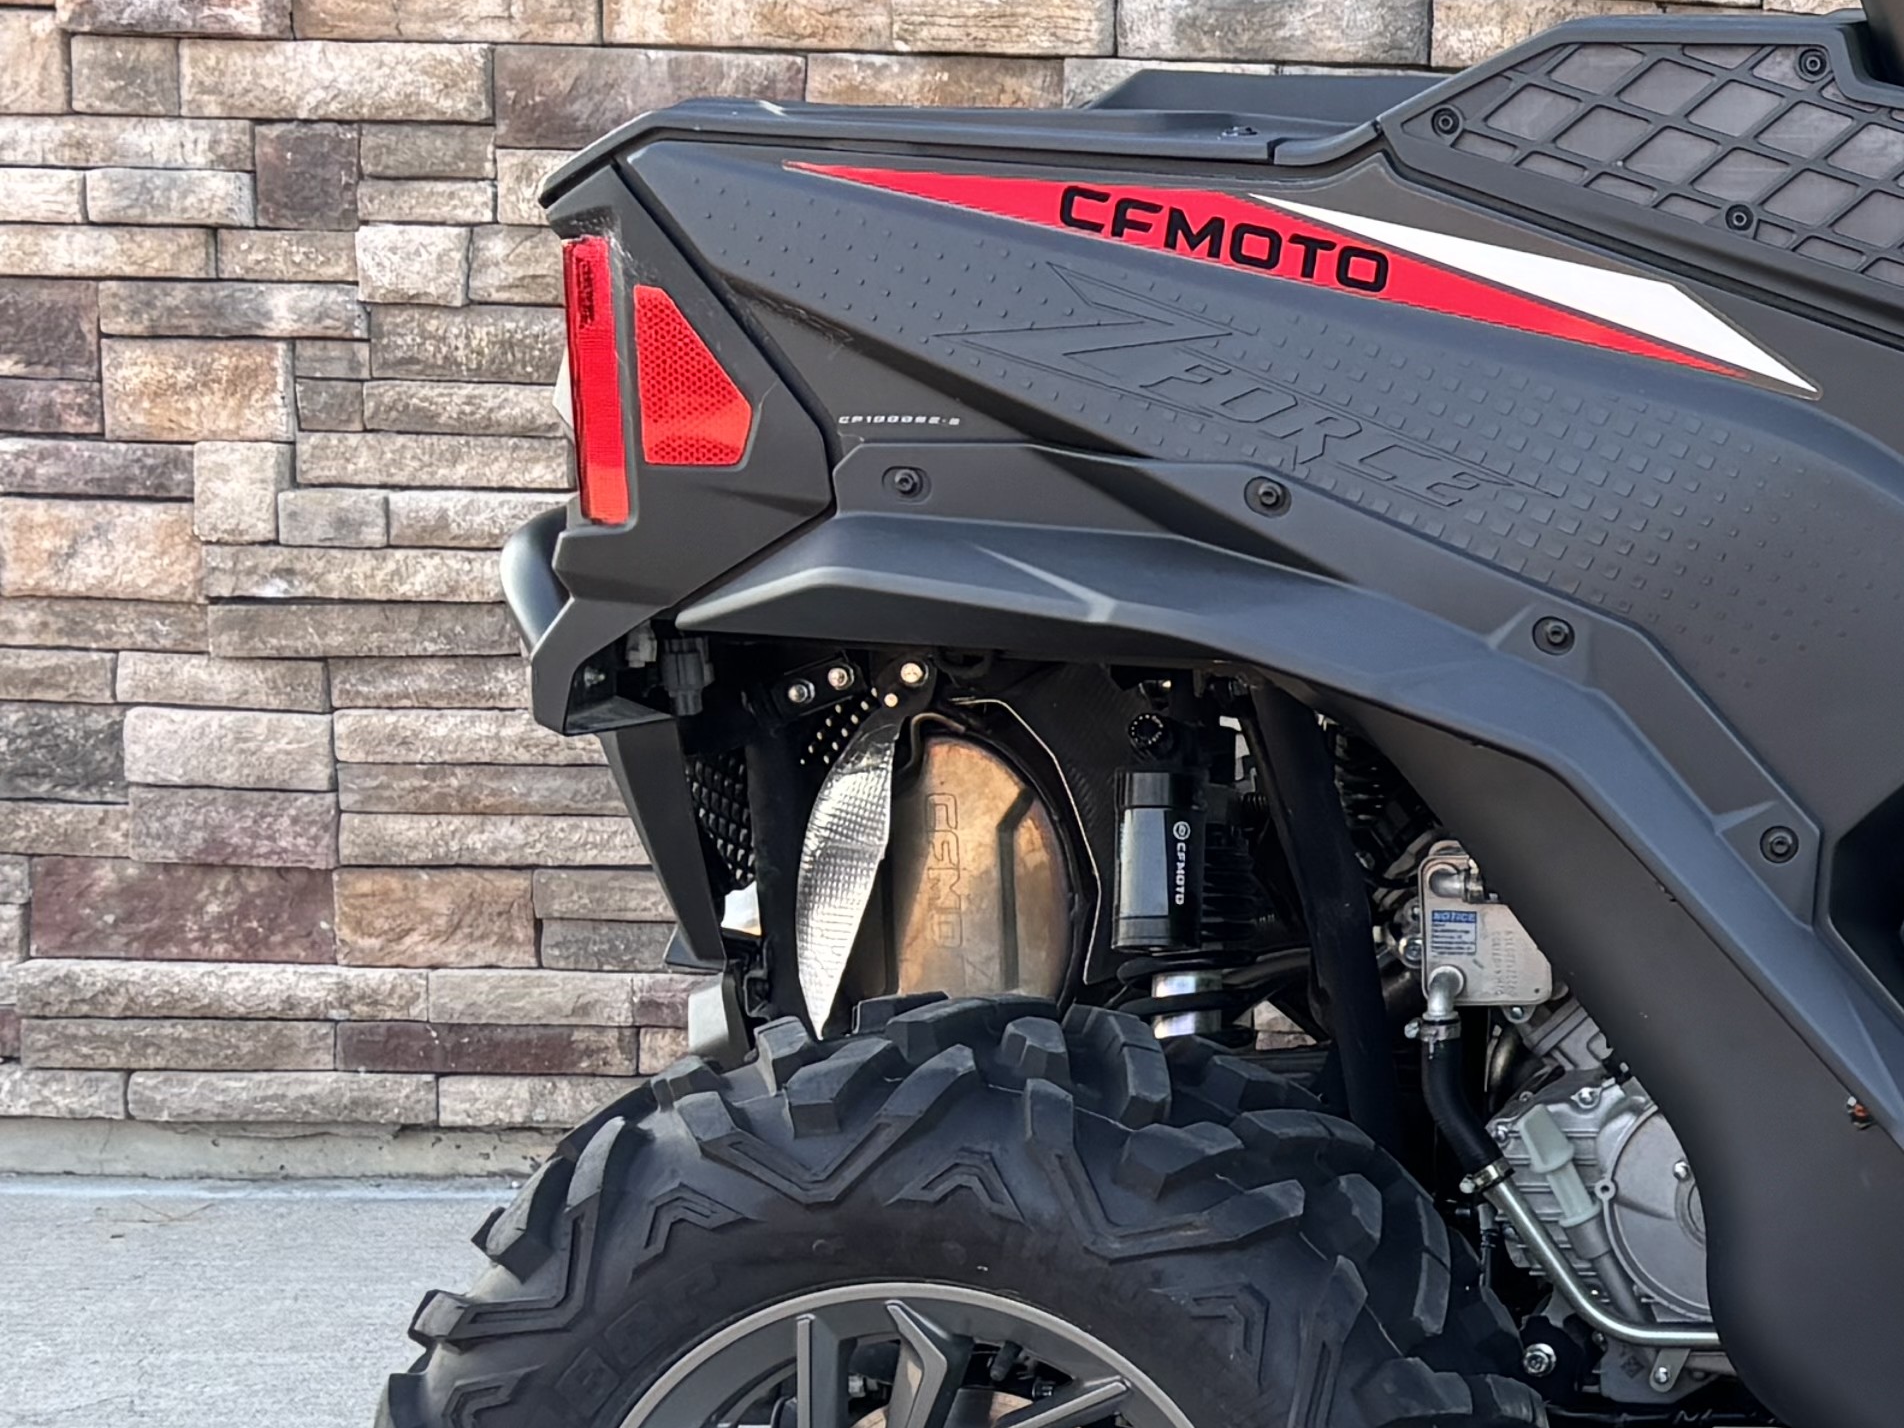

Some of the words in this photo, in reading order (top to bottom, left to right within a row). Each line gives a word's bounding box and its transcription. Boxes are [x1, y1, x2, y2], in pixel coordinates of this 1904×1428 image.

[1059, 185, 1389, 293] CFMOTO
[1175, 842, 1187, 905] CFMOTO
[1433, 912, 1476, 922] NOTICE
